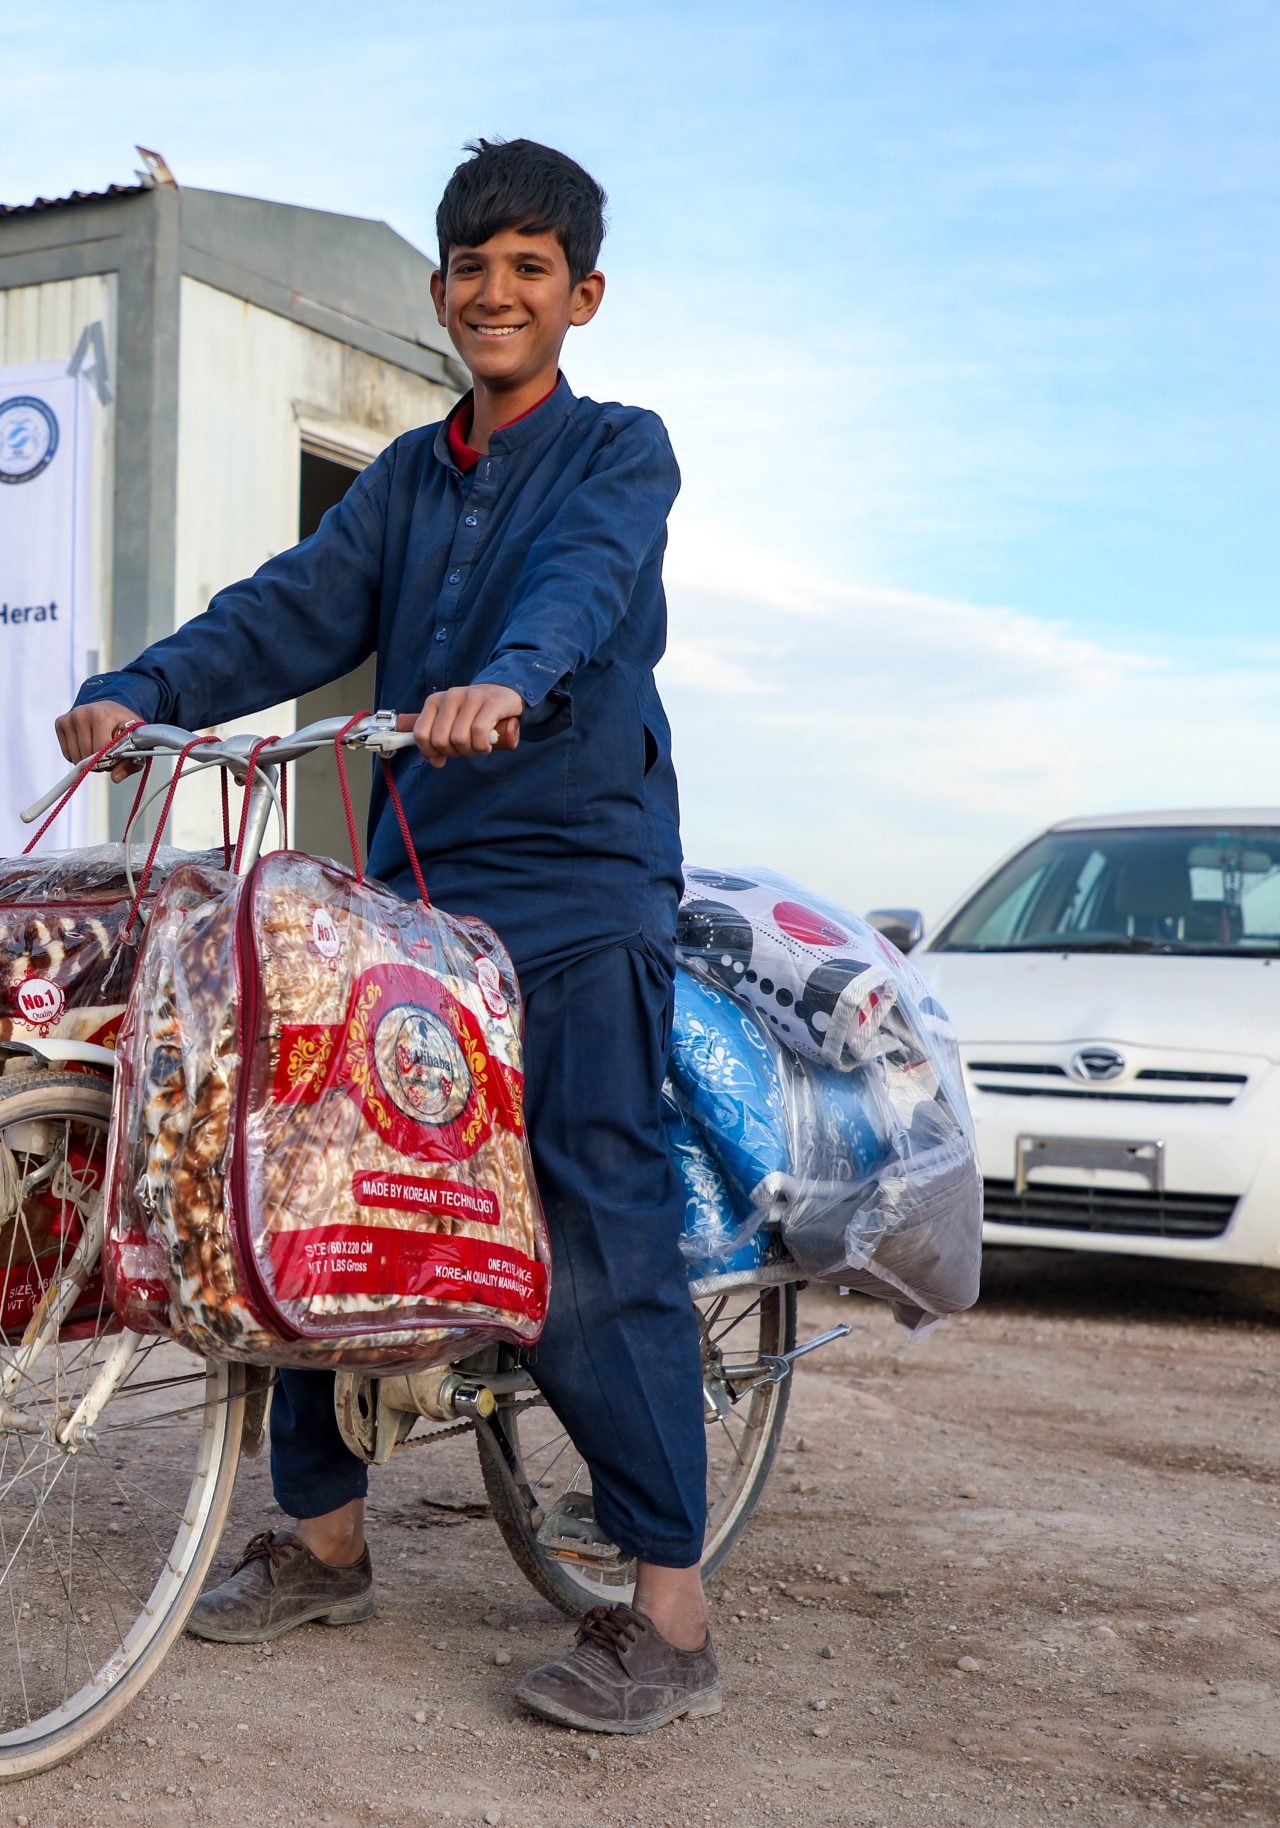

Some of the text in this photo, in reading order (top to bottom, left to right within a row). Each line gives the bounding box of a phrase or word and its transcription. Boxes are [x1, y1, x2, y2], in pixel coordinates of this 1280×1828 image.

[317, 924, 337, 942] No.1
[21, 989, 55, 1011] No.1
[32, 1010, 54, 1021] Quality
[362, 1181, 389, 1197] MADE
[390, 1184, 403, 1197] BY
[403, 1186, 437, 1204] KOREAN
[360, 1242, 373, 1255] CM
[347, 1259, 367, 1272] Gross
[488, 1258, 501, 1271] ONE
[435, 1265, 472, 1282] KOREAN
[473, 1271, 499, 1287] QUALITY
